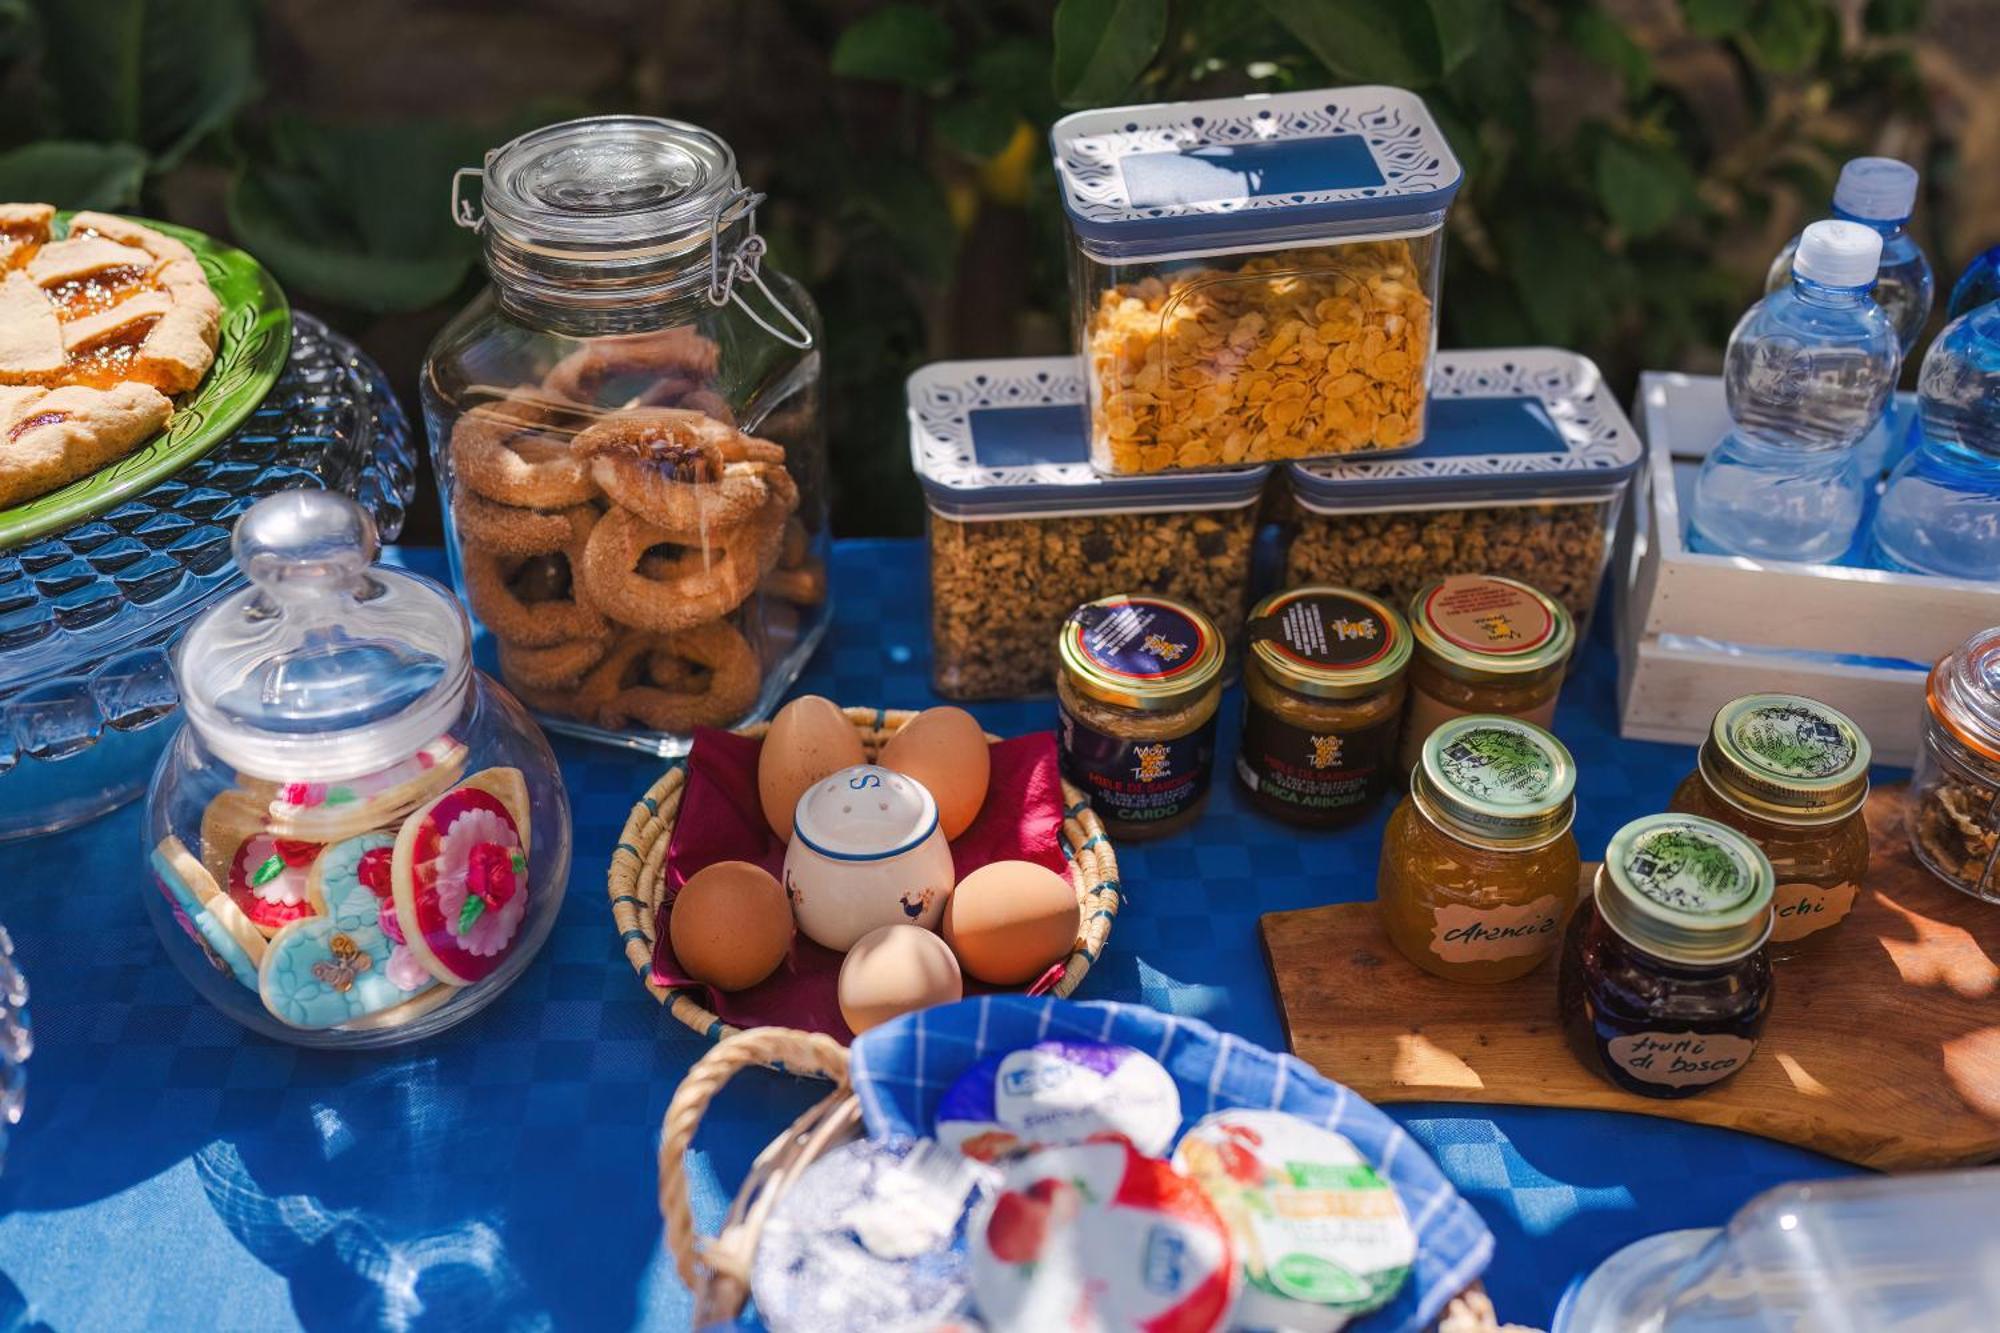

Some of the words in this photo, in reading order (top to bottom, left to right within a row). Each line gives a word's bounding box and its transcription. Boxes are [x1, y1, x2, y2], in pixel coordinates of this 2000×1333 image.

[849, 773, 881, 791] S
[1116, 803, 1180, 820] CARDO
[1774, 896, 1826, 917] chi
[1629, 1053, 1654, 1070] di
[1667, 1055, 1738, 1074] bosco
